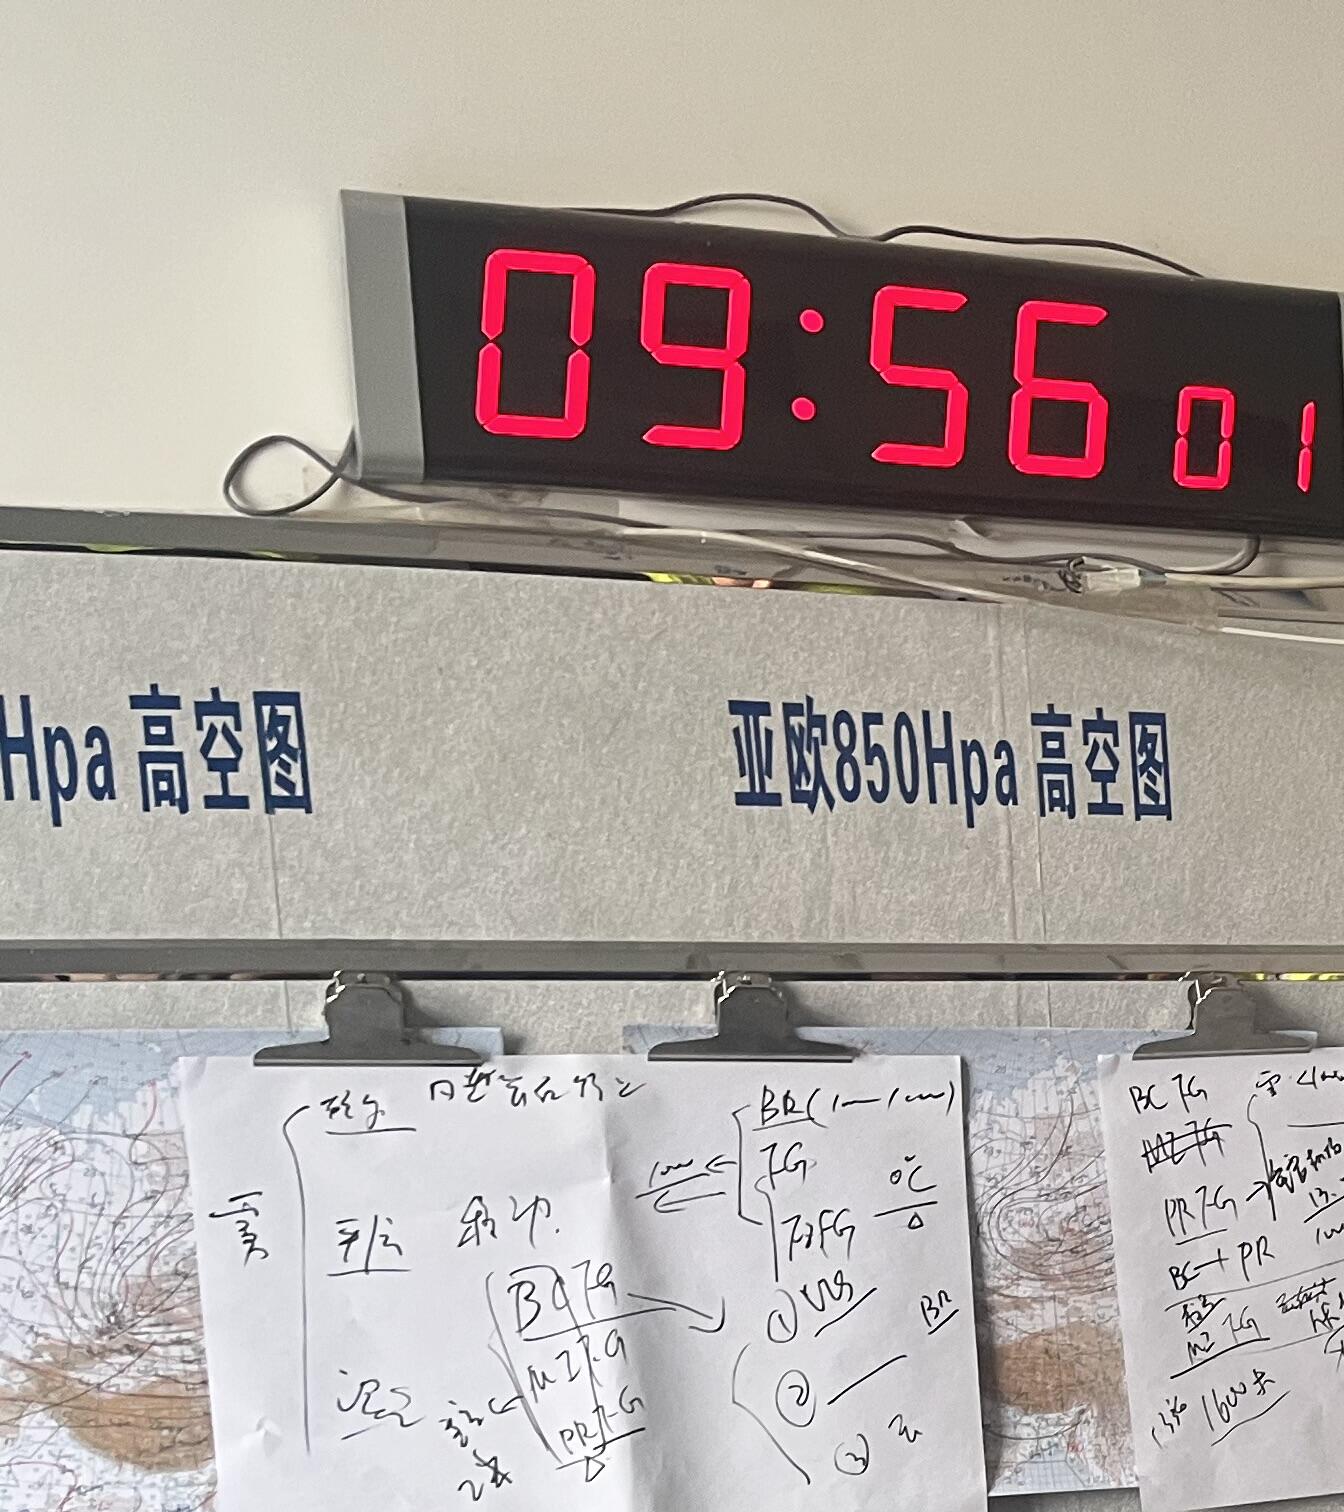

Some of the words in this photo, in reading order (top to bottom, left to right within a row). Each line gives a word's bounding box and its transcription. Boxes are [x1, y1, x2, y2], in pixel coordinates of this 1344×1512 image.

[474, 248, 1109, 480] 09:56
[1173, 385, 1315, 494] 01
[129, 683, 312, 815] 高空图
[727, 694, 1019, 829] 亚欧850Hpa
[1030, 703, 1174, 822] 高空图
